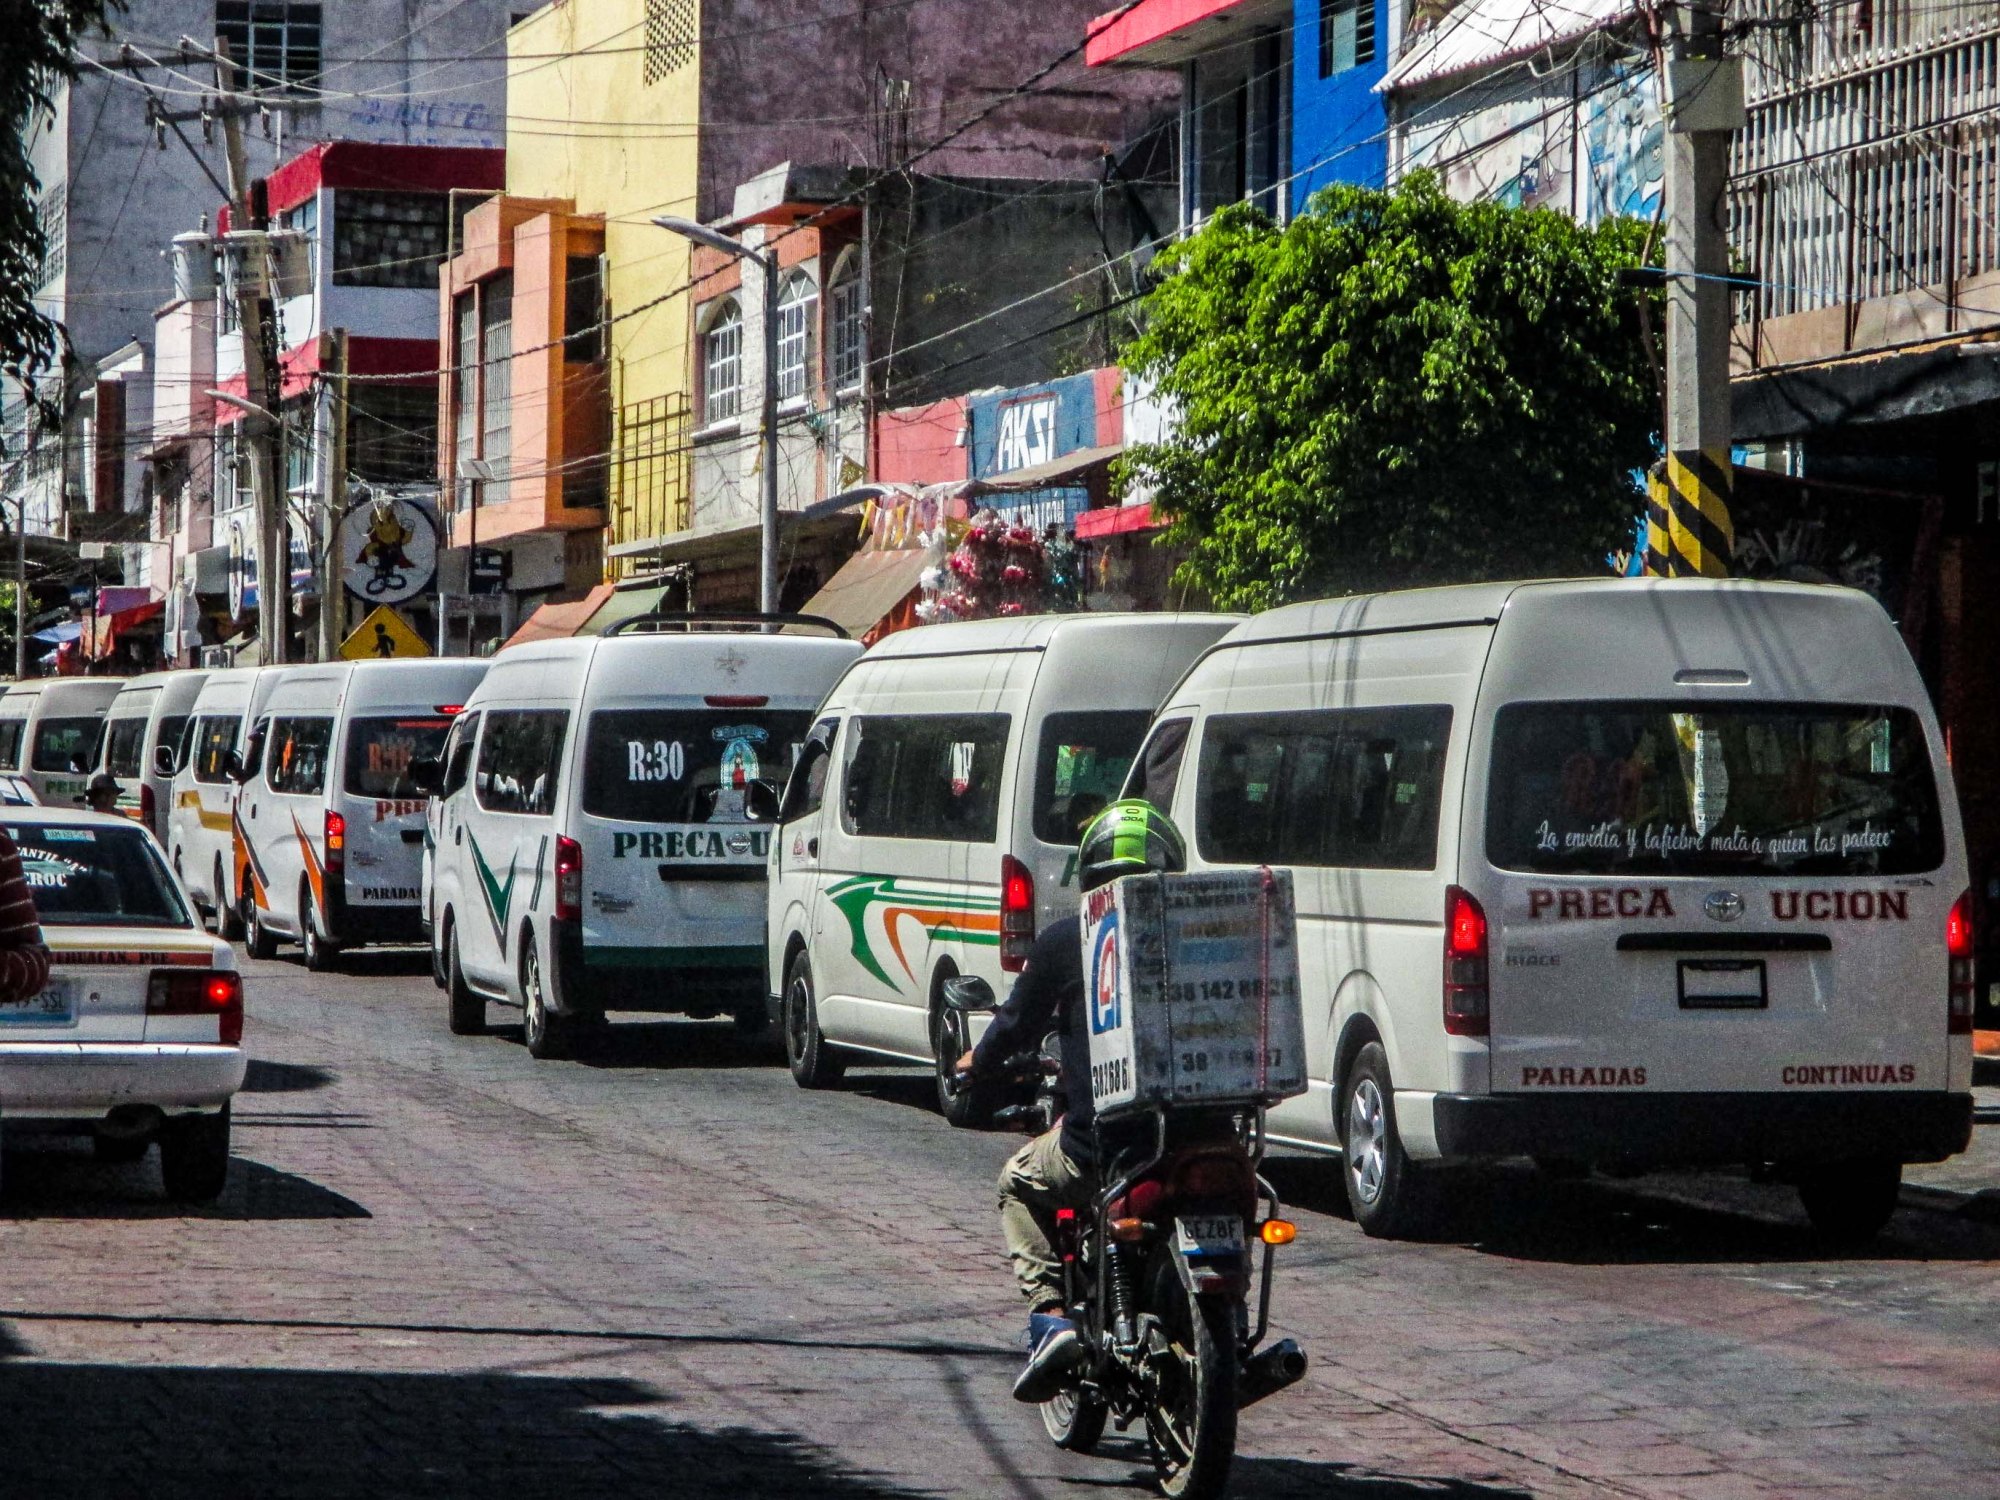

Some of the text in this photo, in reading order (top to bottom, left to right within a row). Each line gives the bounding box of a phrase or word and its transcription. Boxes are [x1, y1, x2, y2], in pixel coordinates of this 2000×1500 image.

[997, 400, 1056, 471] AKSI
[628, 741, 684, 781] R:30
[612, 831, 726, 858] PRECA
[1565, 822, 1620, 848] envidia
[1768, 830, 1808, 862] quien
[1814, 826, 1836, 852] las
[1528, 886, 1909, 921] PRECA UCION
[1521, 1064, 1915, 1087] PARADAS CONTINUAS
